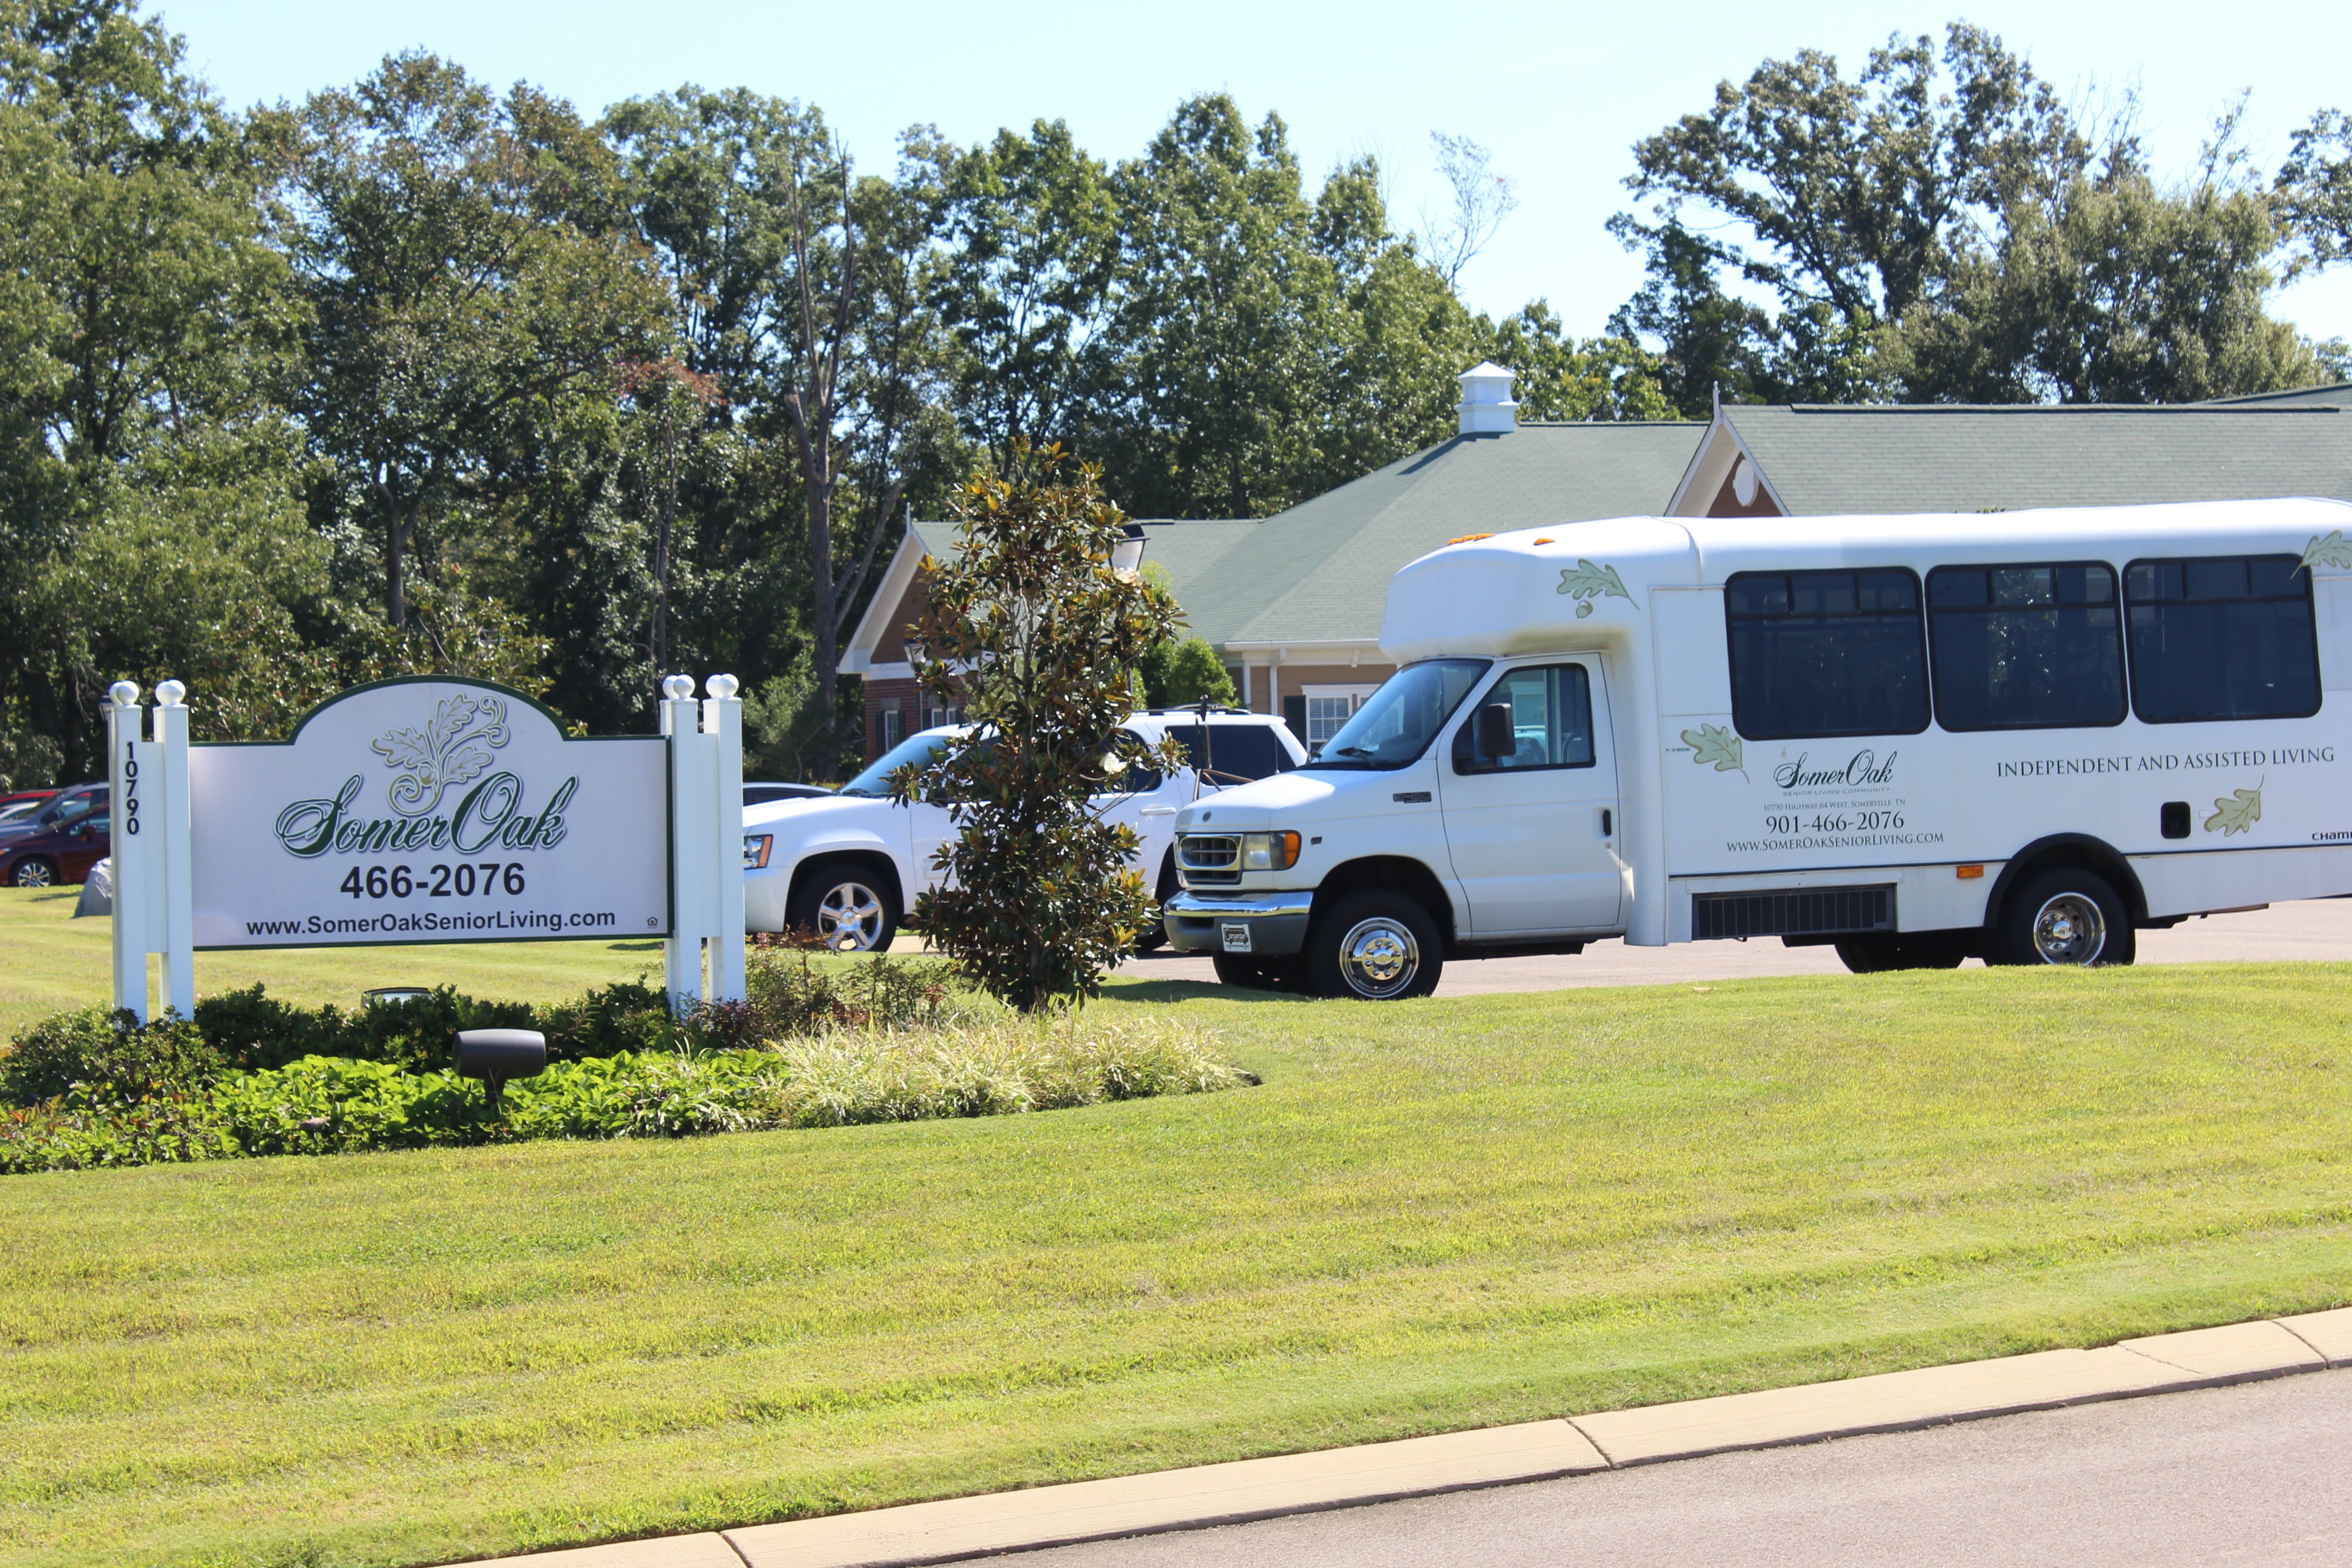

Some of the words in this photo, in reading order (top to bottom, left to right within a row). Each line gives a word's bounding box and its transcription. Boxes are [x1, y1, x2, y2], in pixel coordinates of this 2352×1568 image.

[1997, 757, 2132, 777] INDEPENDENT
[2137, 755, 2178, 770] AND
[2184, 750, 2266, 769] ASSISTED
[2272, 747, 2334, 765] LIVING
[125, 741, 140, 835] 10790
[1765, 810, 1905, 835] 901-466-2076
[340, 862, 525, 899] 466-2076
[246, 910, 616, 935] www.SomerOakSeniorLiving.com
